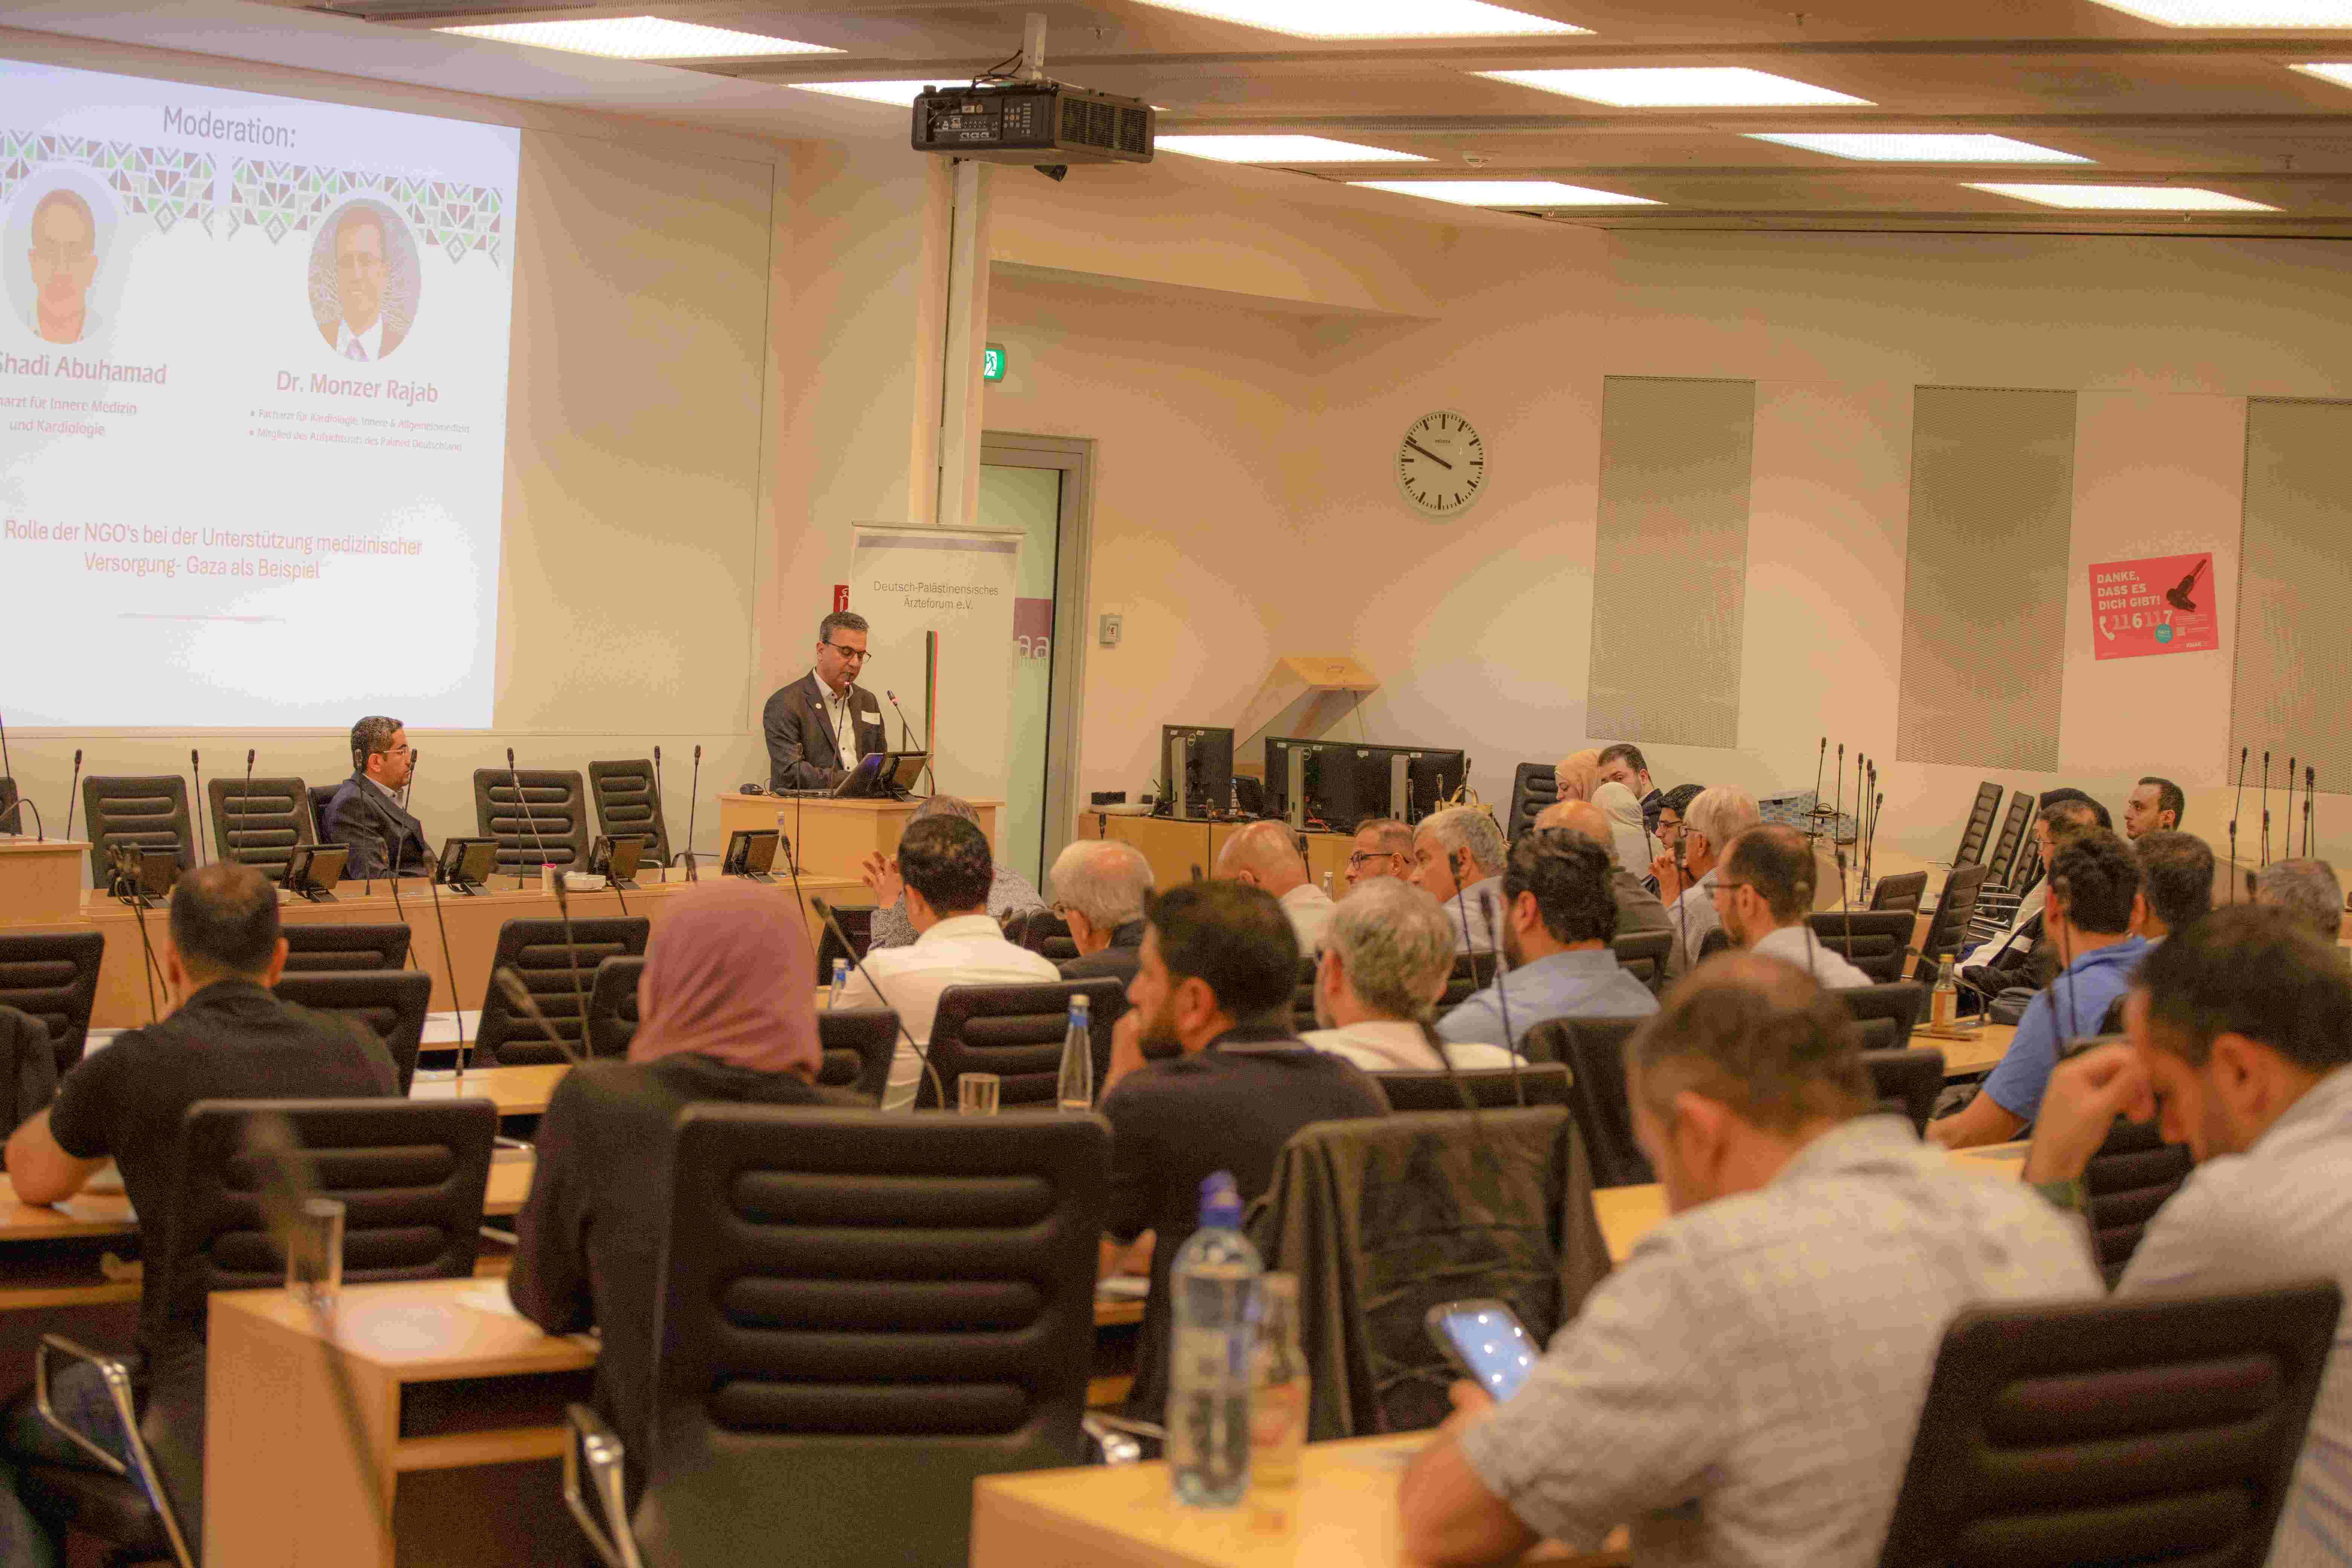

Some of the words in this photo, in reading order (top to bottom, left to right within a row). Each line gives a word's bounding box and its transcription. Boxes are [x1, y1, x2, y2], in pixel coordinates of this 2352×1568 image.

[164, 106, 296, 148] Moderation:
[54, 356, 167, 385] Abuhamad
[277, 371, 304, 393] Dr.
[310, 373, 382, 398] Monzer
[386, 379, 439, 407] Rajab
[30, 396, 47, 410] für
[50, 398, 88, 412] Innere
[91, 400, 137, 414] Medizin
[9, 419, 33, 431] und
[37, 419, 105, 439] Kardiologie
[5, 519, 48, 541] Rolle
[52, 522, 80, 541] der
[84, 523, 139, 543] NGO's
[144, 524, 167, 544] bei
[172, 526, 198, 546] der
[203, 527, 314, 555] Unterstützung
[317, 534, 423, 555] medizinischer
[84, 552, 181, 578] Versorgung-
[187, 555, 226, 576] Gaza
[231, 558, 254, 577] als
[259, 558, 320, 582] Beispiel
[2097, 571, 2140, 583] DANKE,
[874, 581, 998, 595] Deutsch-Palästinensisches
[2098, 585, 2128, 597] DASS
[2132, 584, 2147, 594] ES
[904, 594, 953, 609] Ärzteforum
[956, 599, 974, 609] e.V.
[2098, 599, 2126, 610] DICH
[2130, 596, 2160, 607] GIBT!
